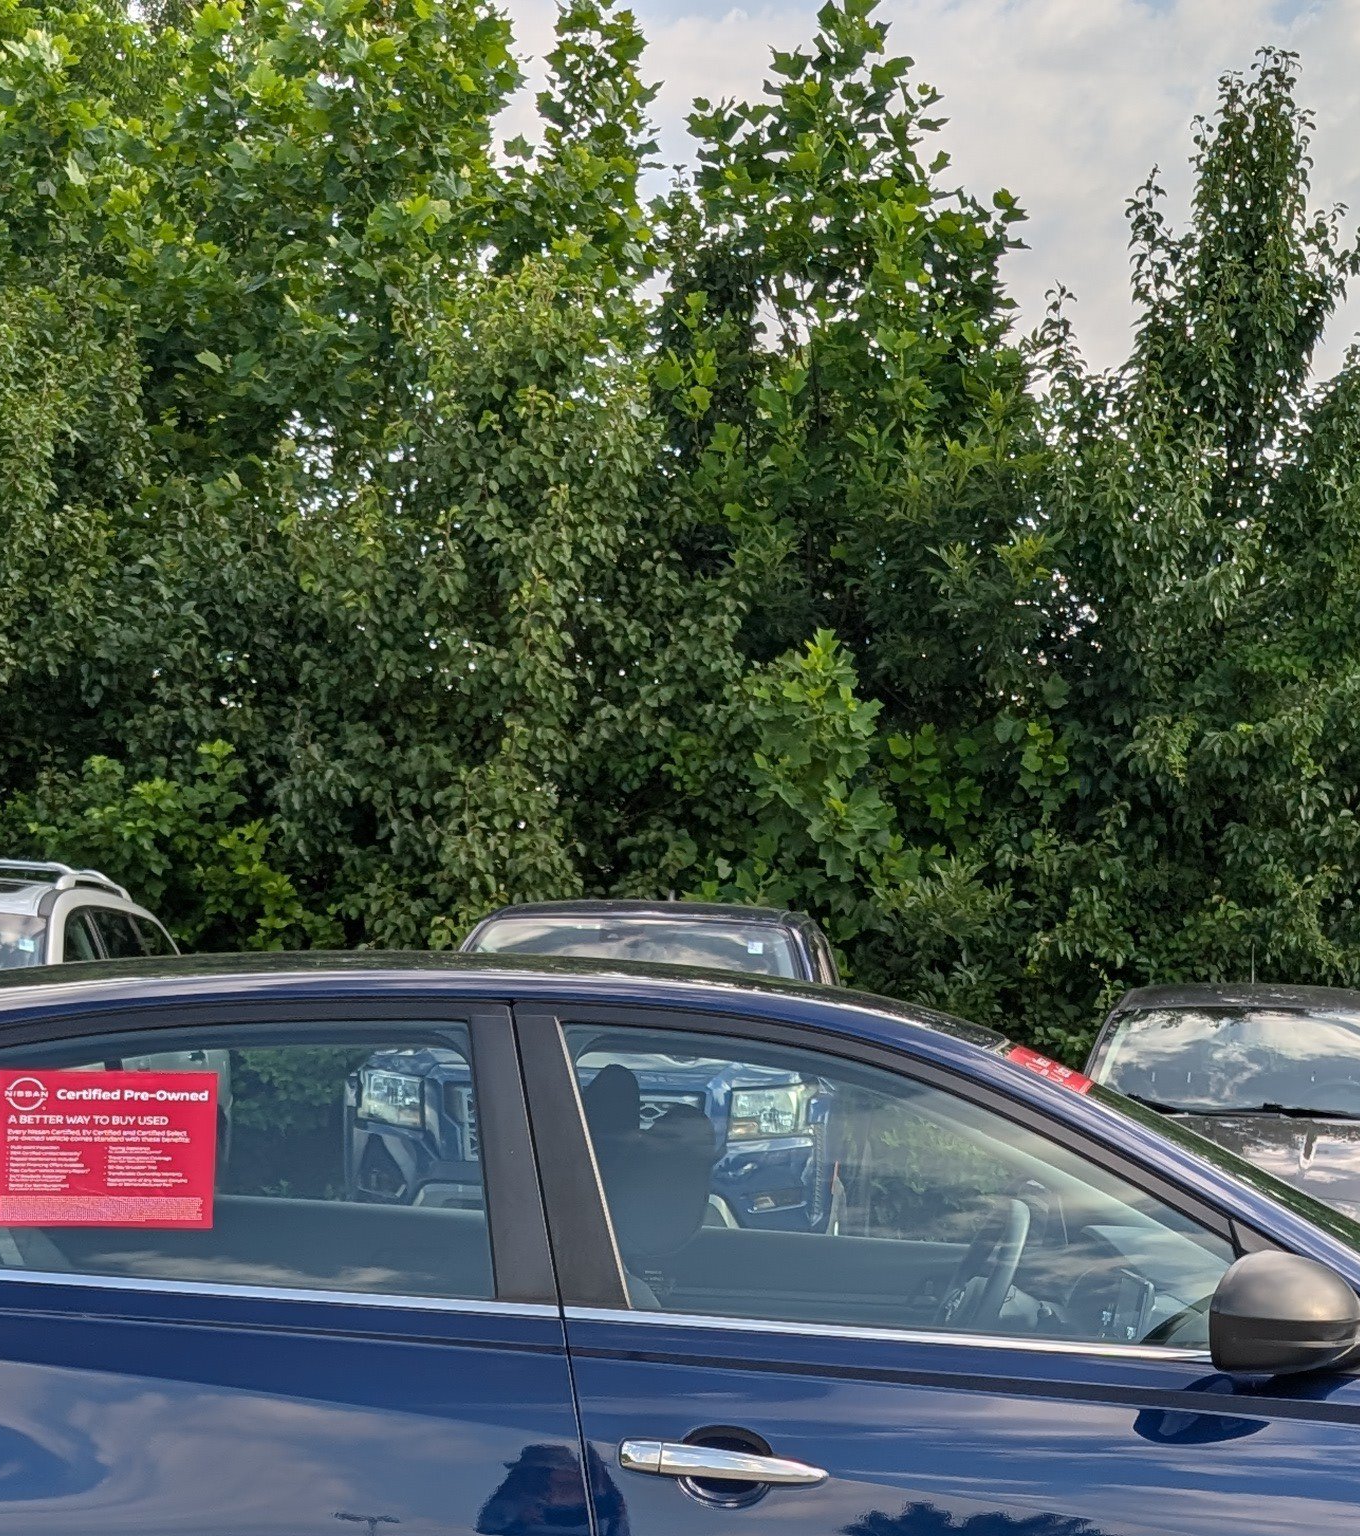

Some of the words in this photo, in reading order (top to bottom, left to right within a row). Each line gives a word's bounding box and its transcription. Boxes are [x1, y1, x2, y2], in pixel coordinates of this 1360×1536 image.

[4, 1090, 49, 1098] NISSAN
[56, 1088, 121, 1100] Certified
[123, 1089, 210, 1101] Pre-Owned
[7, 1115, 18, 1125] A
[19, 1115, 64, 1125] BETTER
[65, 1115, 91, 1125] WAY
[93, 1115, 110, 1125] TO
[111, 1115, 136, 1125] BUY
[137, 1115, 169, 1126] USED
